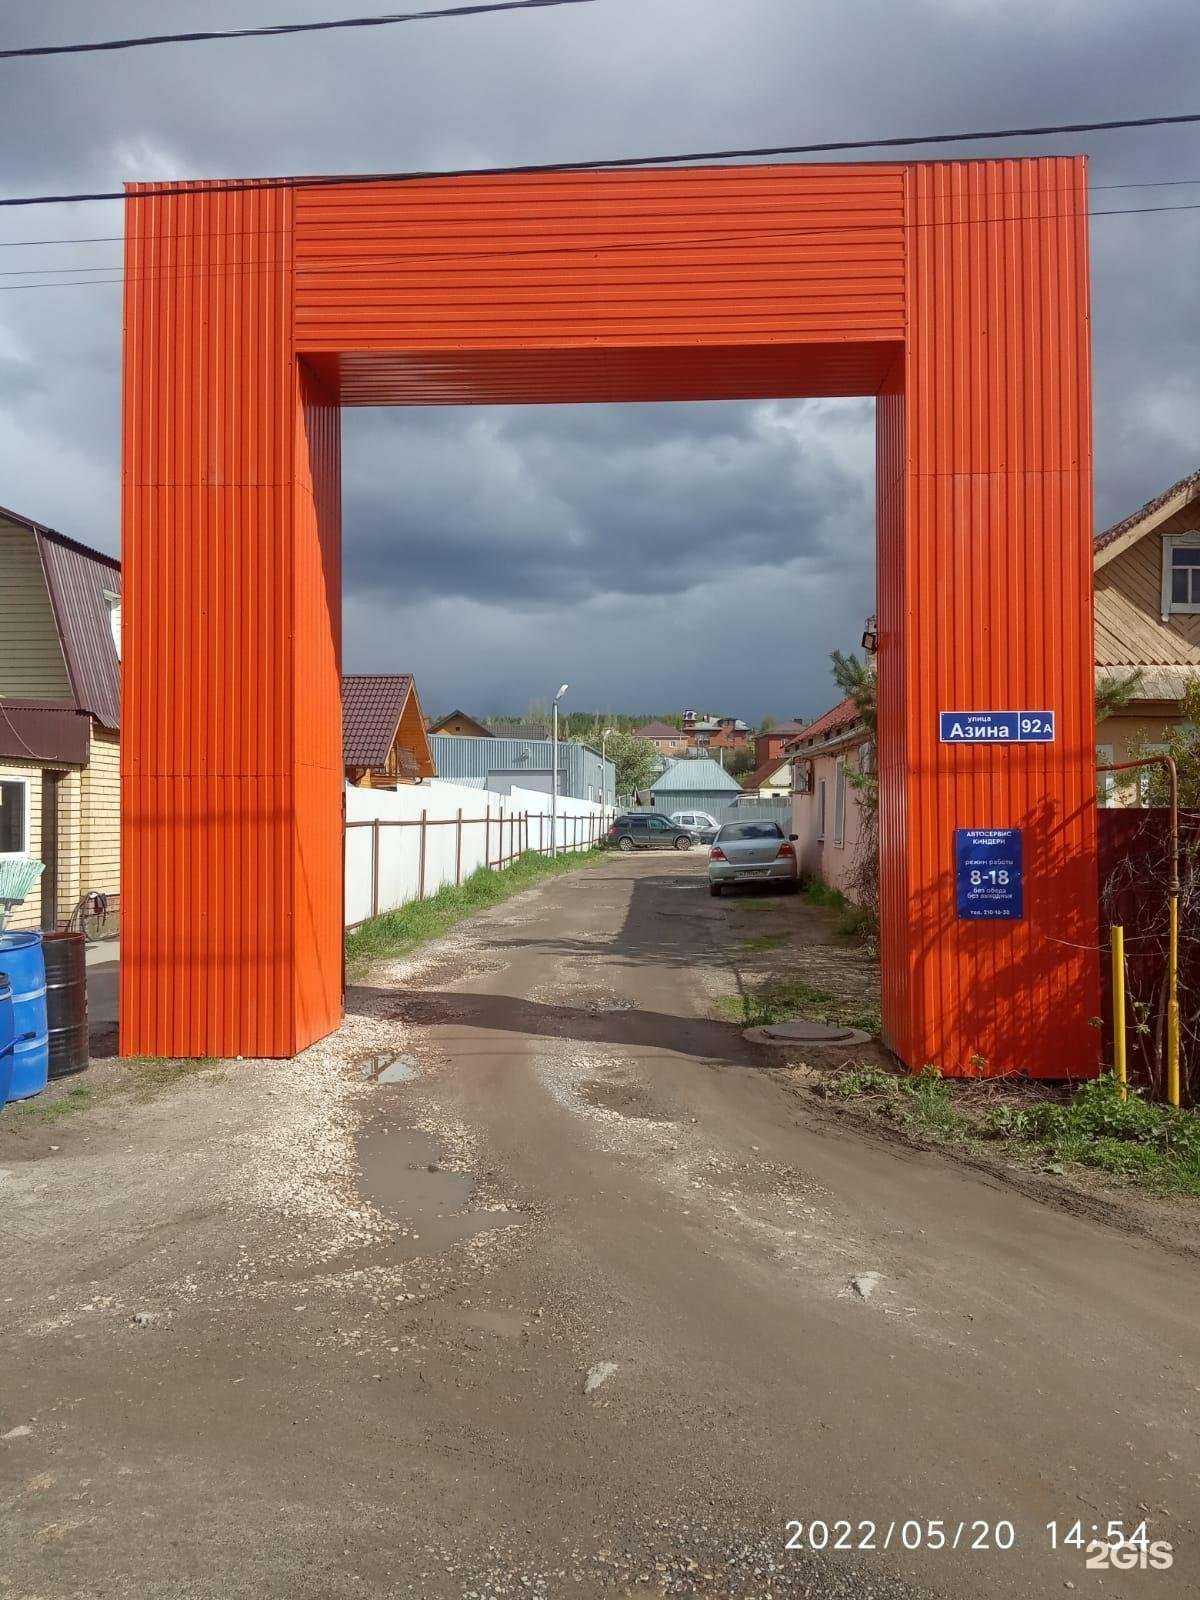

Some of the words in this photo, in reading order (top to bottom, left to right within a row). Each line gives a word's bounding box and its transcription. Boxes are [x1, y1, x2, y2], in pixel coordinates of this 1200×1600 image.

[967, 715, 992, 723] улица
[950, 722, 1009, 738] Азина
[970, 869, 1010, 885] 8-18
